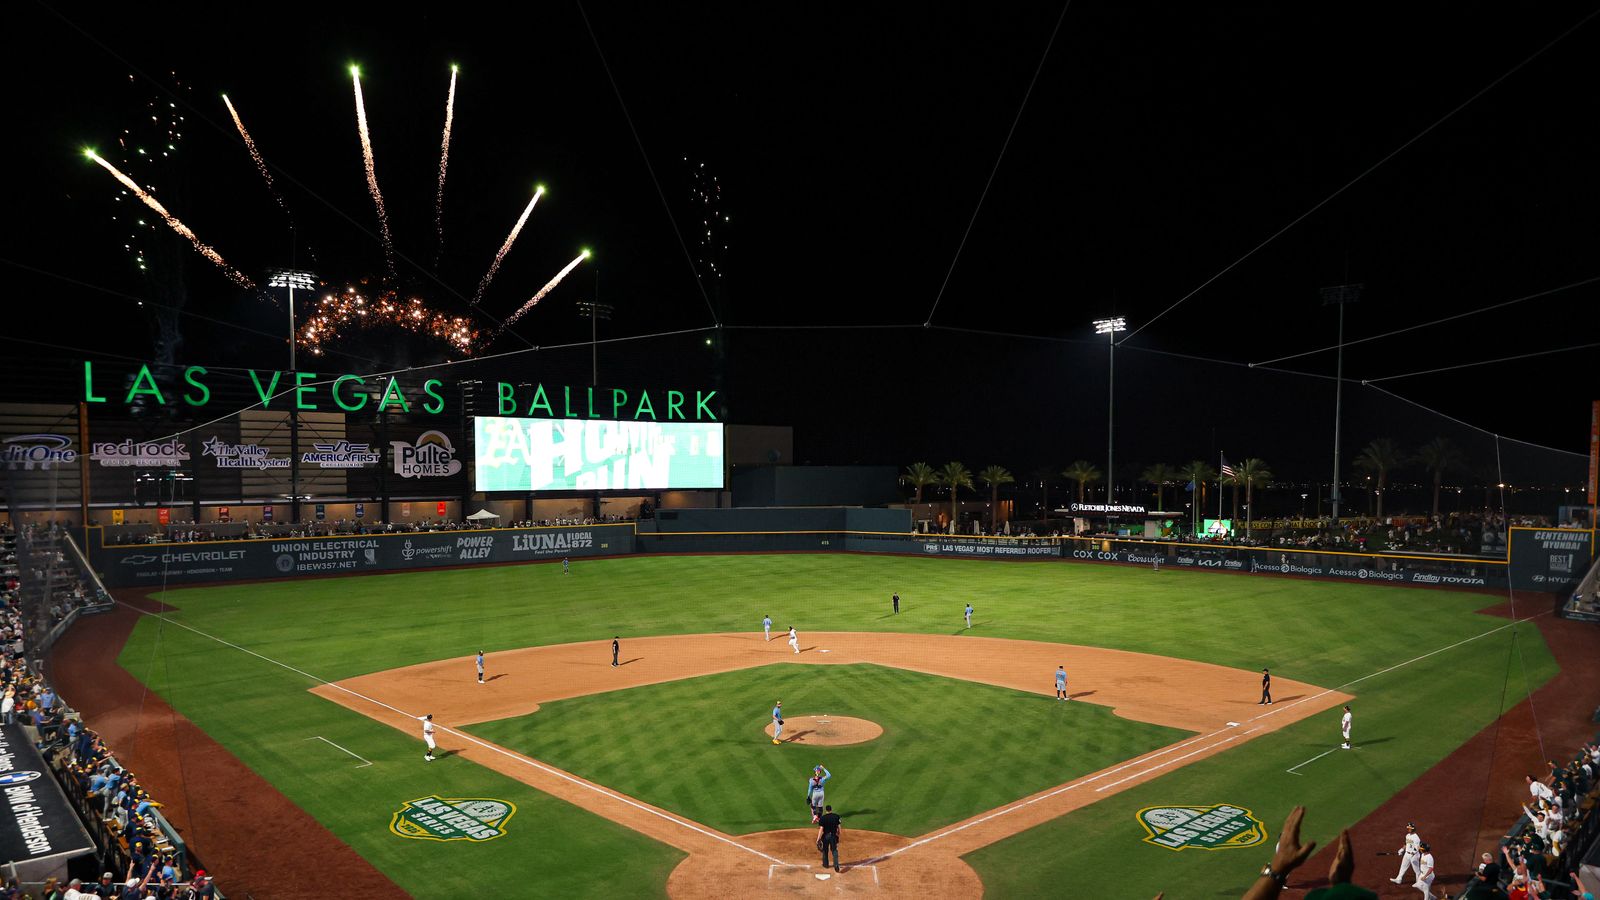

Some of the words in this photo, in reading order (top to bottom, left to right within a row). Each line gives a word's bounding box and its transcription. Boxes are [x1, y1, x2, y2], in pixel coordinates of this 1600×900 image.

[84, 360, 211, 407] LAS
[247, 368, 446, 415] VEGAS
[498, 381, 718, 421] BALLPARK
[236, 444, 269, 457] Valley
[402, 445, 450, 464] Pulte
[217, 456, 256, 467] Health
[257, 458, 290, 470] System
[302, 453, 350, 462] AMERICA
[351, 454, 381, 462] FIRST
[402, 464, 450, 474] HOMES
[1078, 503, 1105, 512] FLETCHER
[1105, 504, 1121, 513] JONES
[1121, 504, 1145, 513] NEVADA
[456, 535, 494, 548] POWER
[512, 532, 572, 551] LiUNA!
[571, 531, 593, 540] LOCAL
[1534, 531, 1590, 542] CENTENNIAL
[271, 542, 310, 553] UNION
[313, 539, 380, 551] ELECTRICAL
[415, 544, 453, 556] powershift
[571, 540, 593, 549] 872
[942, 544, 954, 552] LAS
[954, 544, 976, 553] VEGAS'
[976, 546, 994, 554] MOST
[994, 547, 1026, 555] REFERRED
[1027, 547, 1052, 555] ROOFER
[1542, 540, 1581, 550] HYUNDAI
[161, 550, 247, 563] CHEVROLET
[299, 550, 355, 561] INDUSTRY
[459, 547, 491, 559] ALLEY
[1073, 549, 1093, 559] COX
[1097, 551, 1118, 561] COX
[296, 560, 358, 571] IBEW357.NET
[1254, 562, 1280, 571] Acesso
[1290, 565, 1323, 575] Biologics
[1328, 567, 1358, 577] Acesso
[1368, 570, 1404, 581] Biologics
[1412, 572, 1441, 583] Findlay
[1441, 576, 1485, 585] TOYOTA
[4, 784, 37, 805] BMW
[410, 812, 455, 835] SERIES
[411, 797, 453, 815] LAS
[437, 811, 499, 840] VEGAS
[14, 809, 52, 855] Henderson
[1152, 827, 1200, 848] LAS
[1182, 805, 1245, 832] VEGAS
[1199, 820, 1247, 843] SERIES
